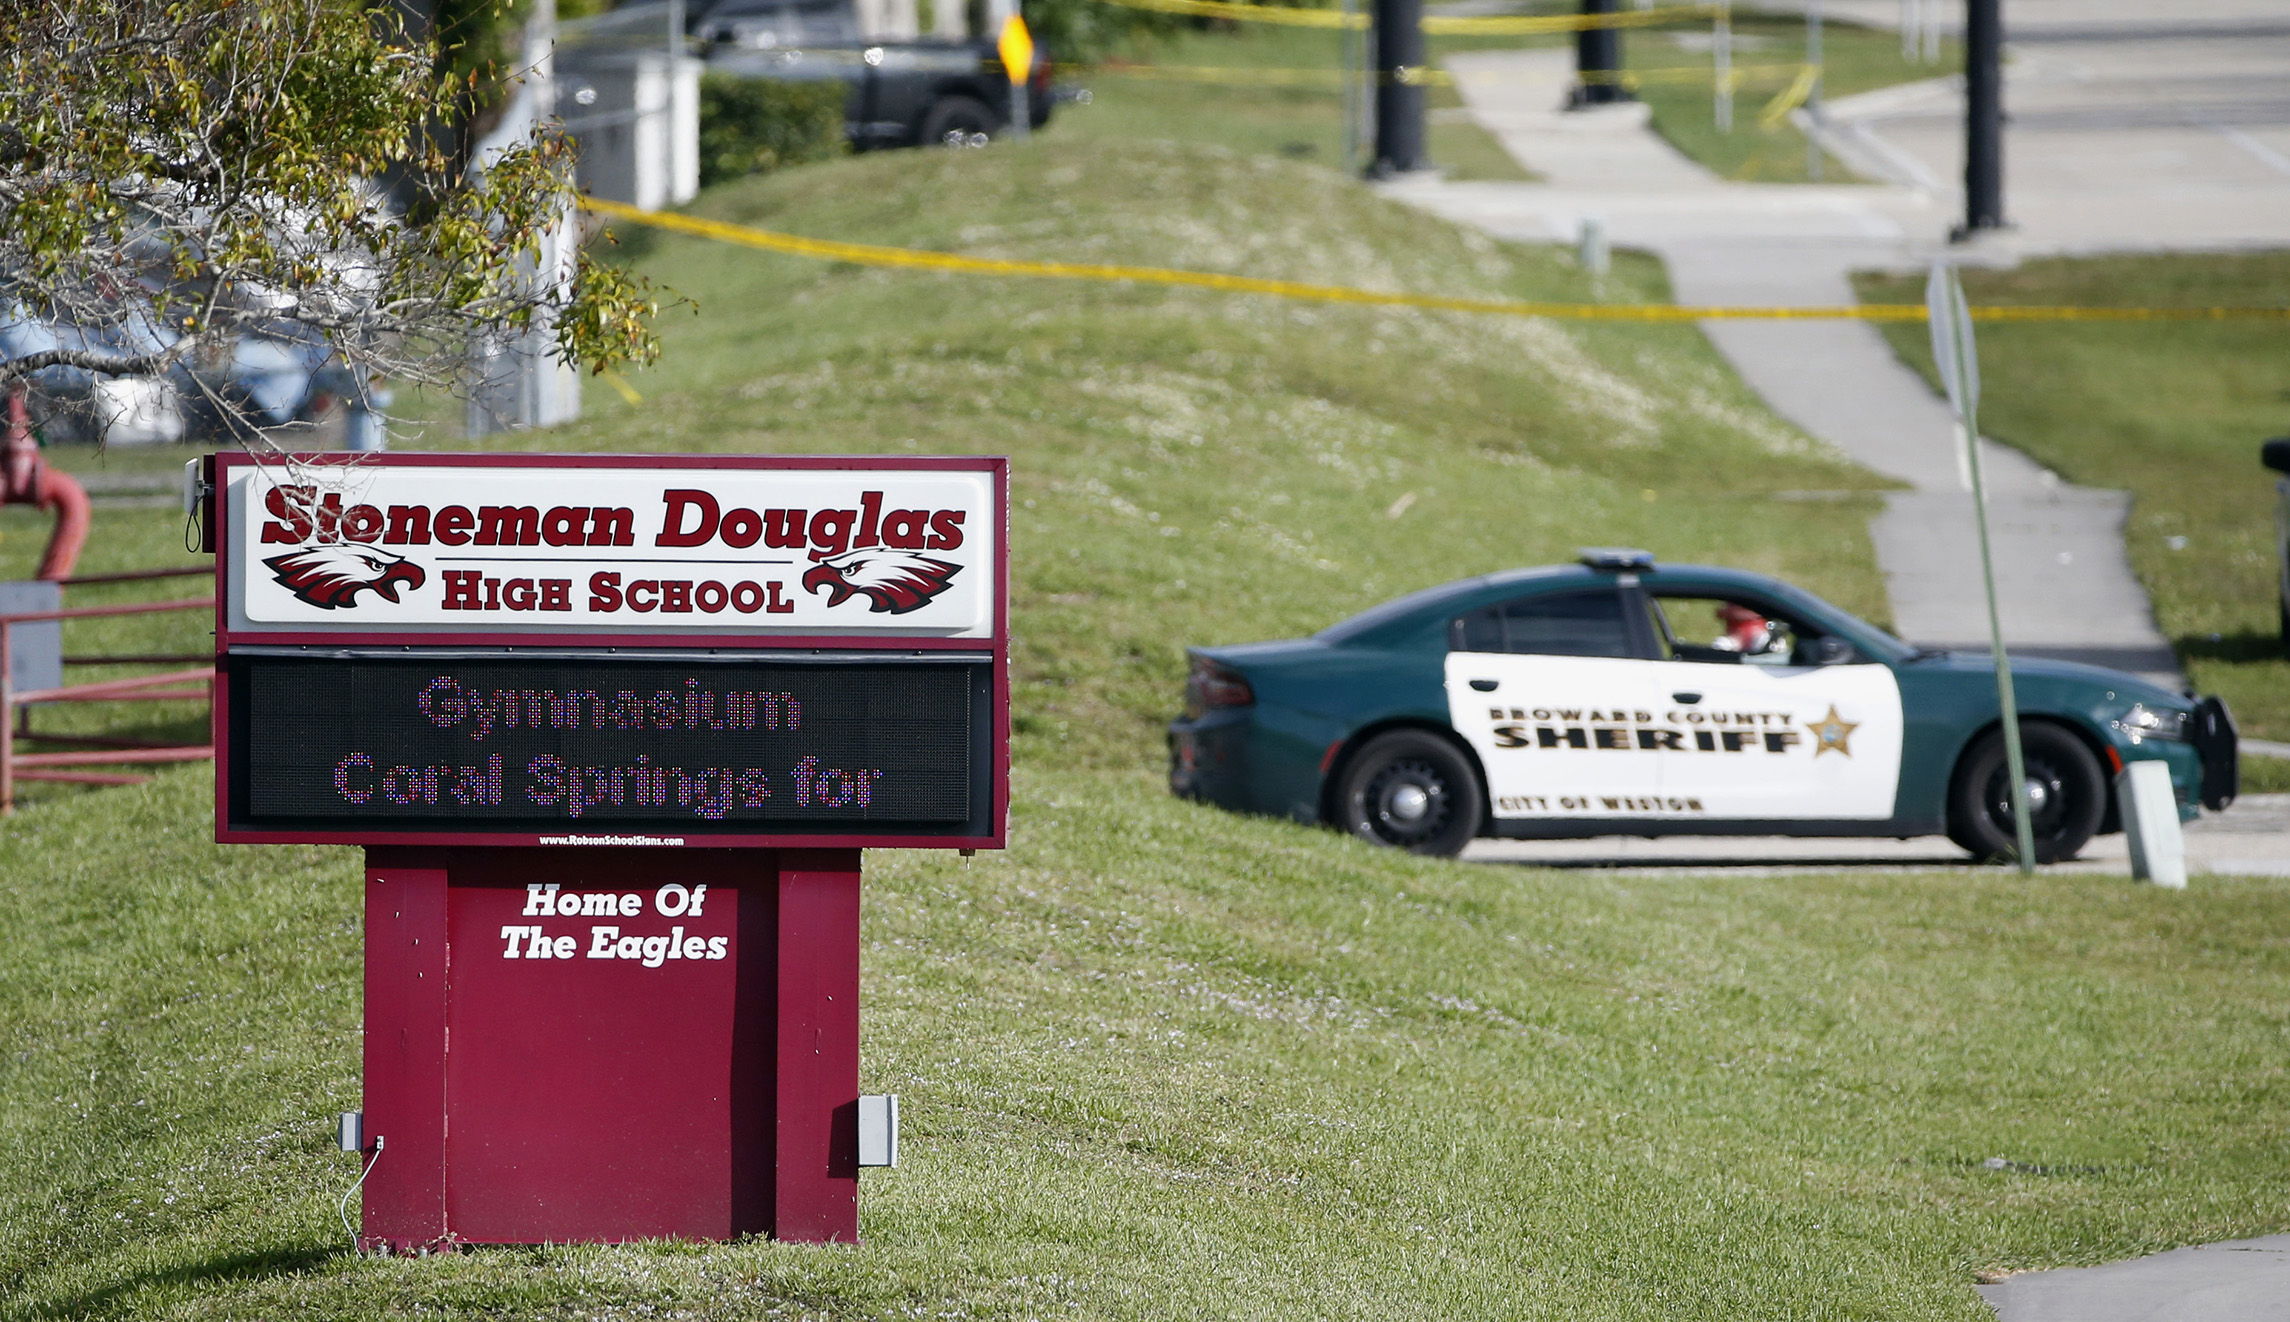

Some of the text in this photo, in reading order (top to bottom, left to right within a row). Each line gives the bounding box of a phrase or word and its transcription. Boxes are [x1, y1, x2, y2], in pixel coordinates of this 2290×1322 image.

[260, 484, 966, 563] Stoneman Douglas
[442, 570, 794, 613] HIGH SCHOOL
[419, 676, 800, 740] Gymnasium
[1489, 709, 1793, 725] BROWARD COUNTY
[1494, 727, 1802, 752] SHERIFF
[335, 752, 883, 819] Coral Springs for
[1499, 797, 1549, 810] CITY
[1560, 797, 1589, 810] OF
[539, 835, 684, 846] www.RobsonSchoolSigns.com
[522, 883, 707, 917] Home Of
[500, 925, 728, 968] The Eagles
